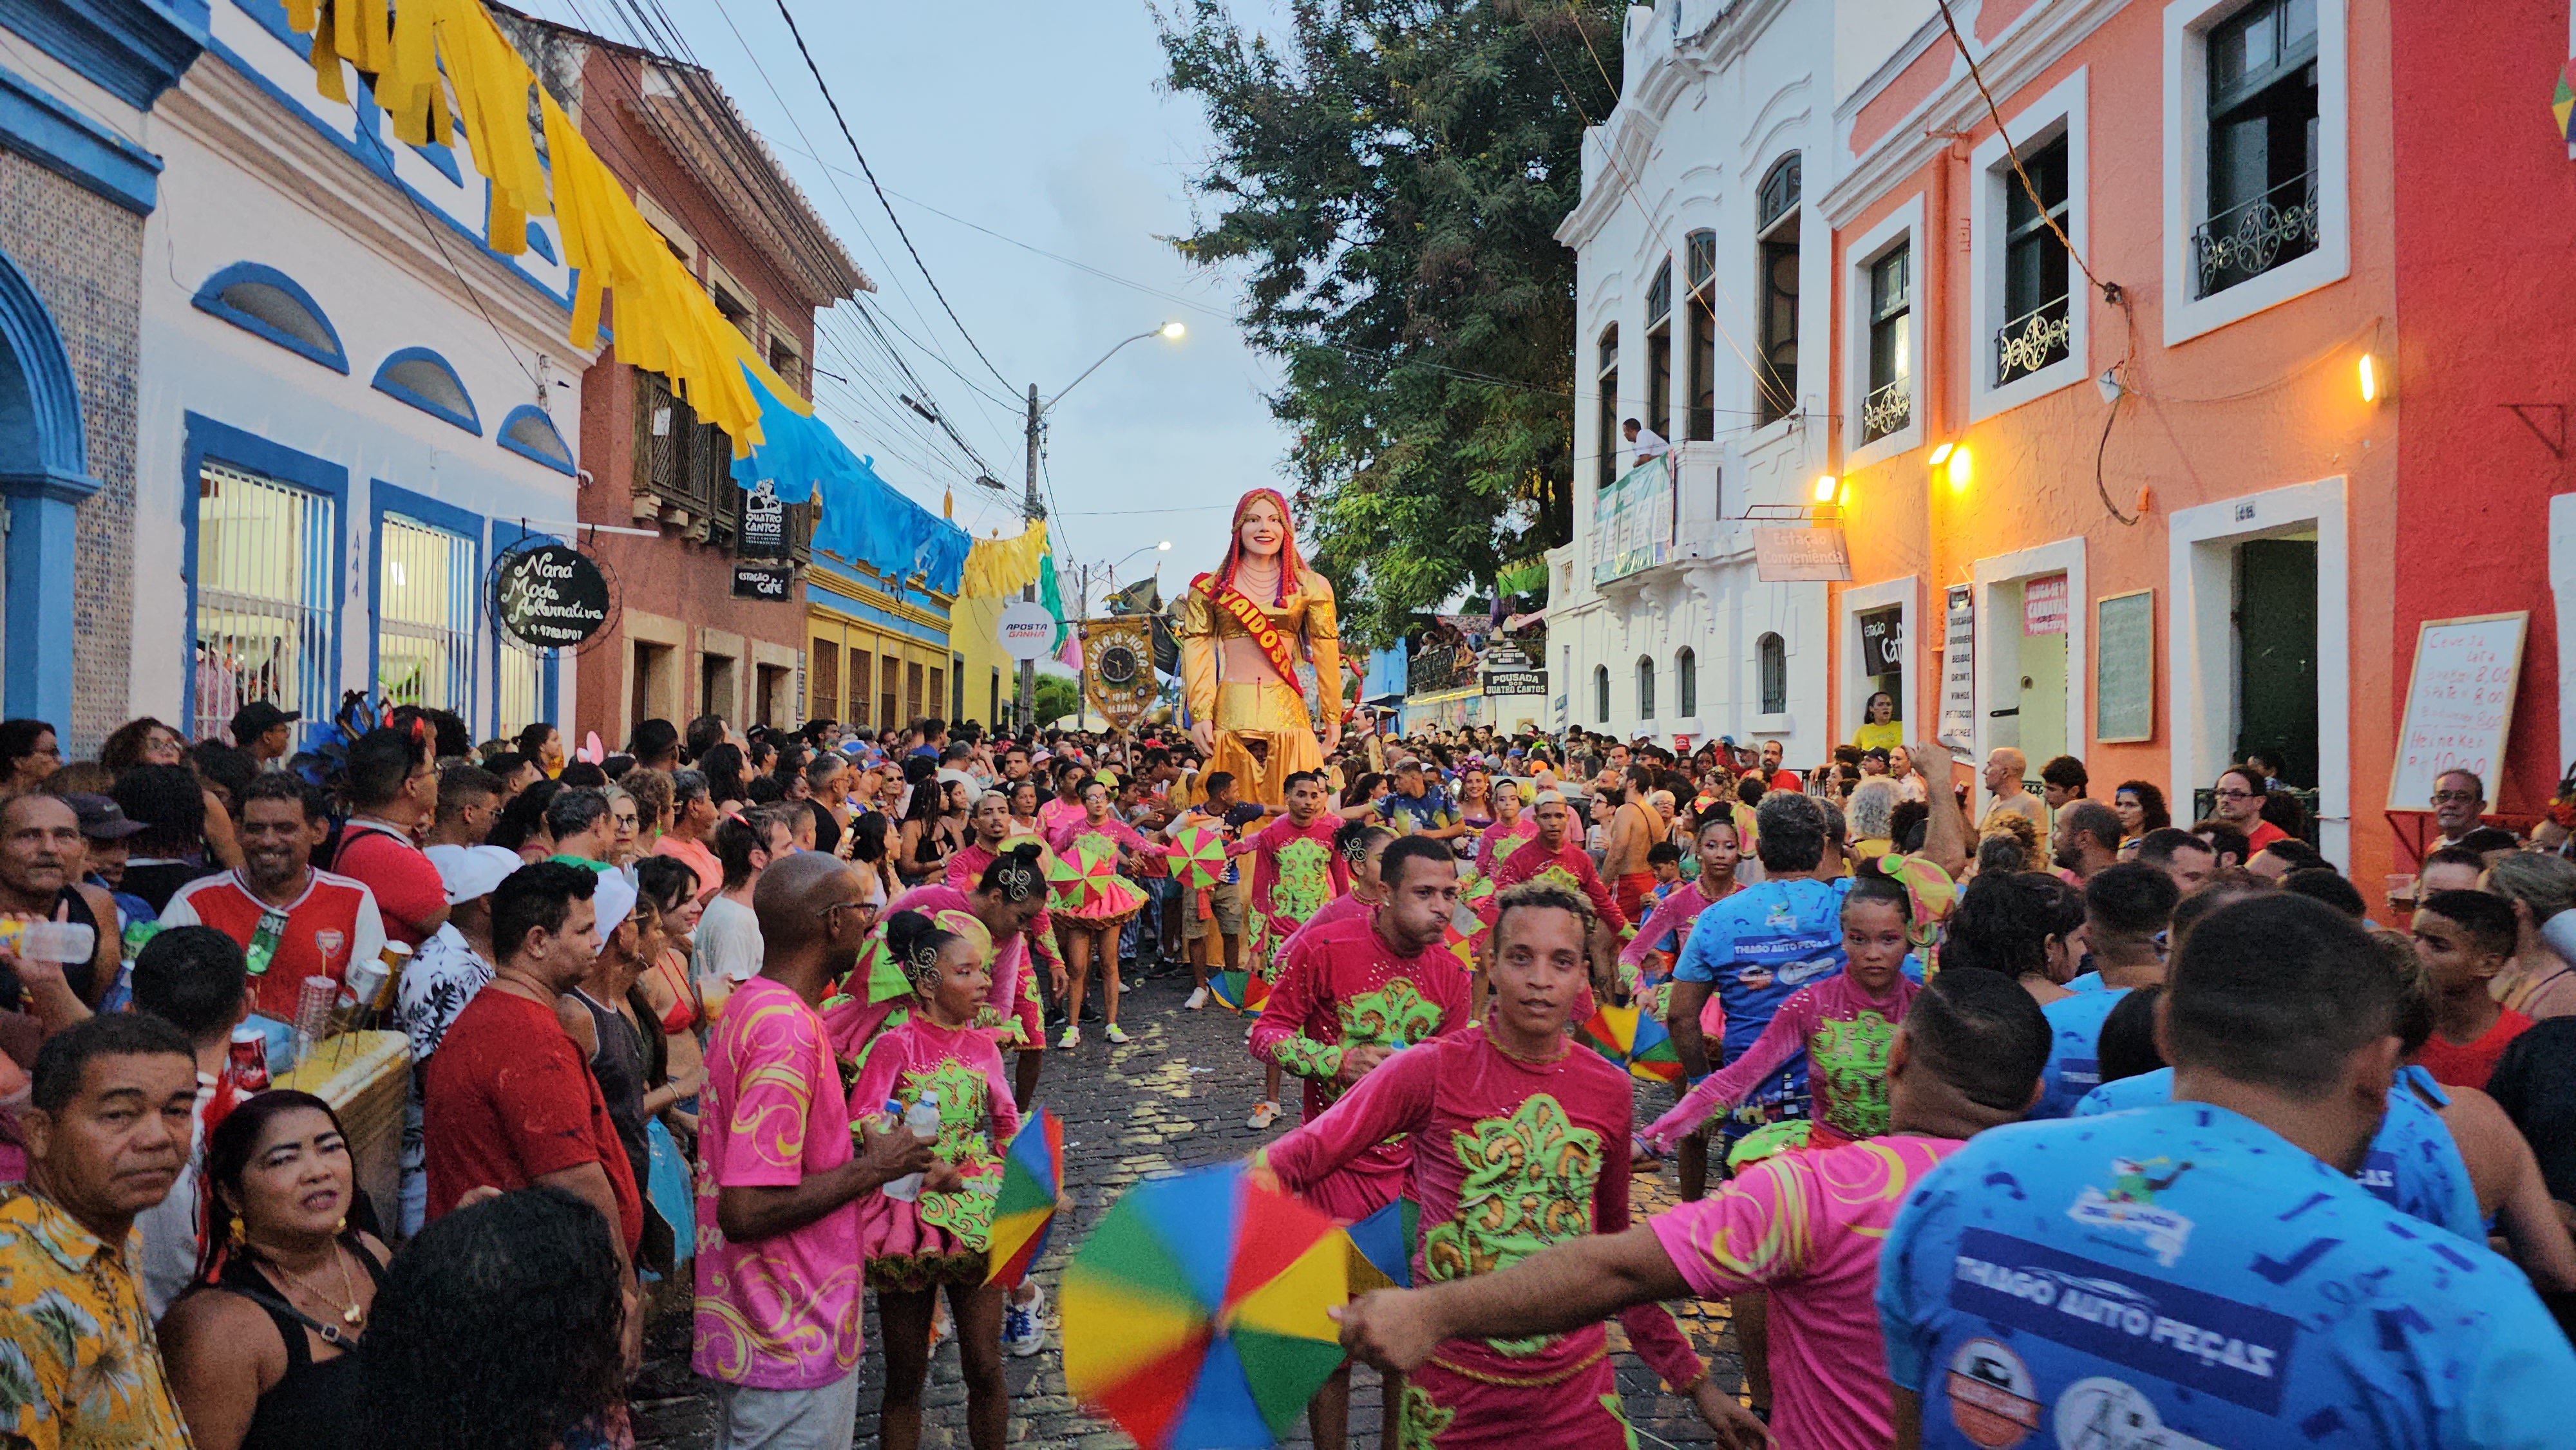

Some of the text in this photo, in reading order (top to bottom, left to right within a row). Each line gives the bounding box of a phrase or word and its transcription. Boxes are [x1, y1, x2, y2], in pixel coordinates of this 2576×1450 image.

[746, 513, 782, 523] QUATRO
[745, 522, 781, 533] CANTOS
[1774, 531, 1827, 549] Estação
[1763, 549, 1844, 564] Conveniência
[514, 552, 576, 578] Naná
[500, 576, 559, 603] Moda
[1218, 592, 1291, 679] VAIDOSA
[1882, 622, 1902, 664] Caf
[1492, 673, 1539, 684] POUSADA
[1486, 685, 1546, 694] QUATRO CANTOS
[1107, 704, 1139, 714] OLINDA
[1734, 944, 1770, 954] THIAGO
[1770, 942, 1797, 953] AUTO
[1955, 1256, 2278, 1379] THIAGO AUTO PEÇAS
